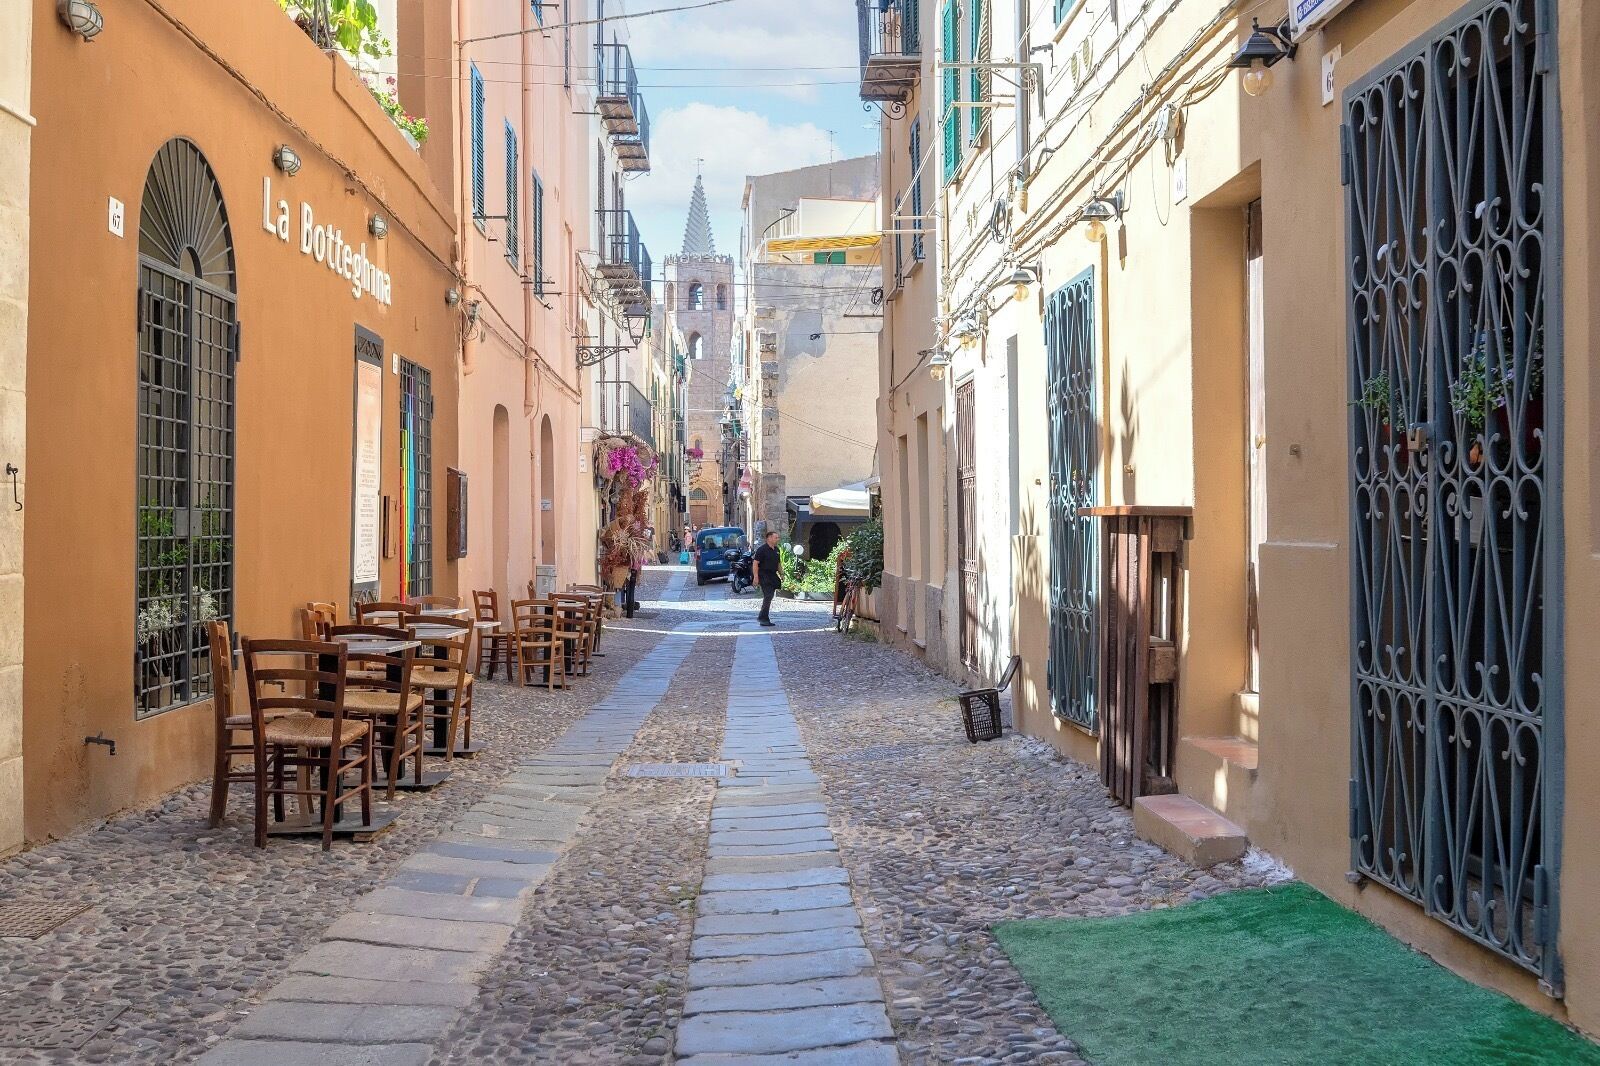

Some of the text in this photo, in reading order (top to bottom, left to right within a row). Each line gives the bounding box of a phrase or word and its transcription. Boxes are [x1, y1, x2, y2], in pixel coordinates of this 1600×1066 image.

[112, 213, 121, 229] 67
[262, 176, 392, 306] La Botteghina
